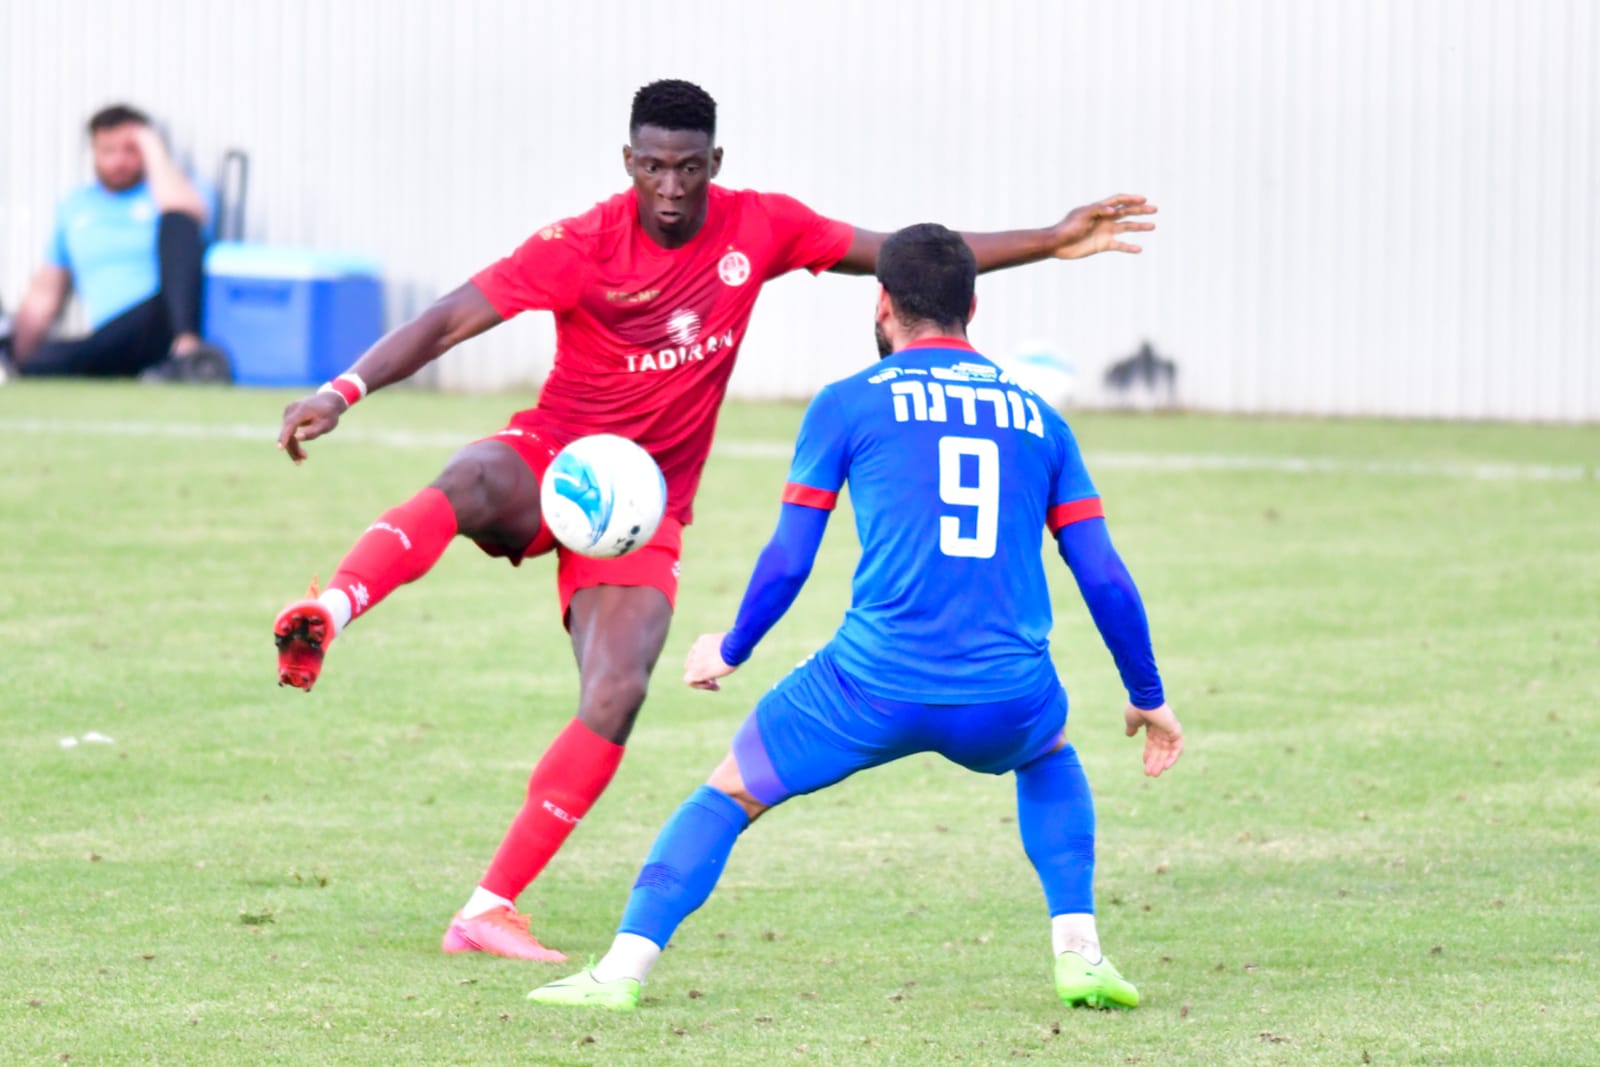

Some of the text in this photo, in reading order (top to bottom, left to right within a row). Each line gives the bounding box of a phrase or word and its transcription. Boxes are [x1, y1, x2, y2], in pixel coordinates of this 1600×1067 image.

[624, 329, 733, 373] TADIRAN
[891, 381, 1044, 438] גורדנה
[939, 436, 999, 559] 9
